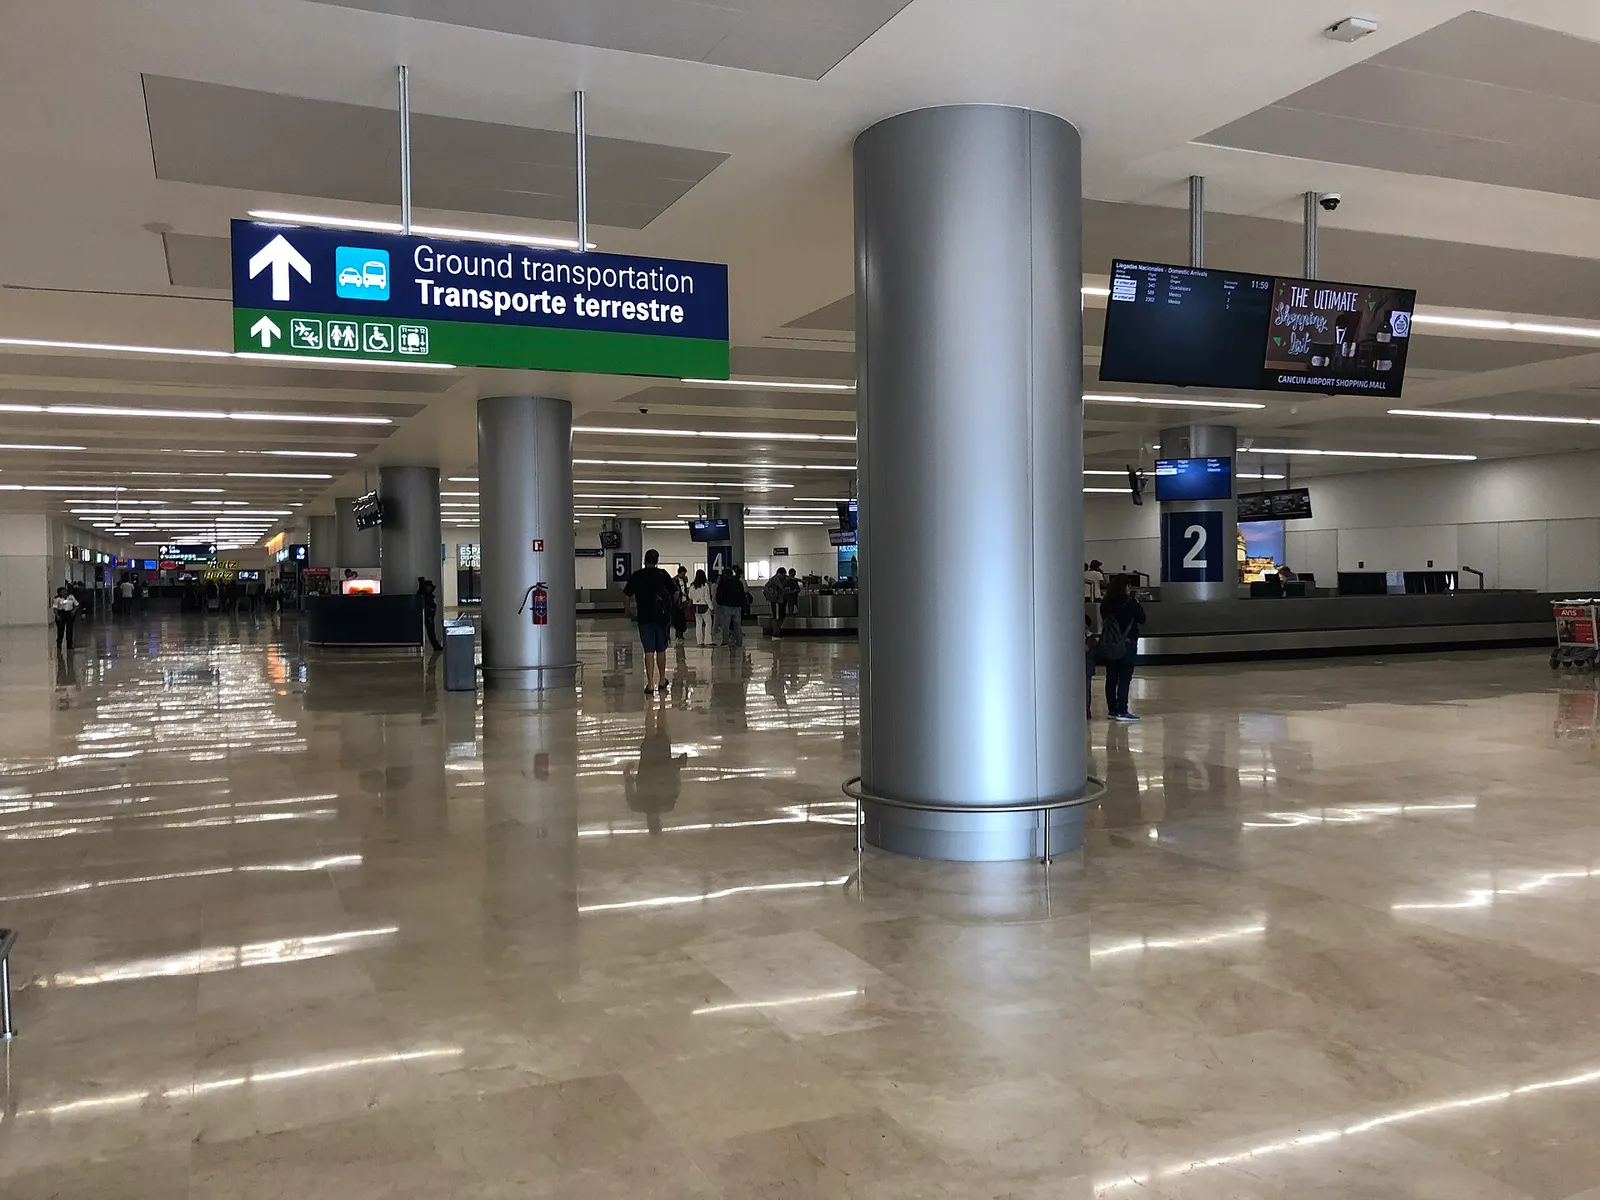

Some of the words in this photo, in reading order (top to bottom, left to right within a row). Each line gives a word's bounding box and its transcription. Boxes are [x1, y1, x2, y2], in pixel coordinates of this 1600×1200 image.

[414, 244, 513, 279] Ground
[521, 256, 694, 294] transportation
[1116, 262, 1138, 270] Llegadas
[1138, 265, 1164, 273] Nacionales
[1168, 268, 1190, 276] Domestic
[1190, 270, 1208, 278] Arrivals
[1252, 280, 1269, 290] 11:59
[414, 278, 567, 316] Transporte
[573, 292, 685, 324] terrestre
[1291, 286, 1310, 308] THE
[1313, 289, 1359, 312] ULTIMATE
[1274, 302, 1328, 333] Shopping
[1278, 375, 1306, 384] CANCUN
[1306, 377, 1335, 386] AIRPORT
[1336, 378, 1369, 388] SHOPPING
[1369, 380, 1386, 390] MALL
[1182, 524, 1208, 568] 2
[615, 558, 625, 577] 5
[712, 552, 724, 575] 4
